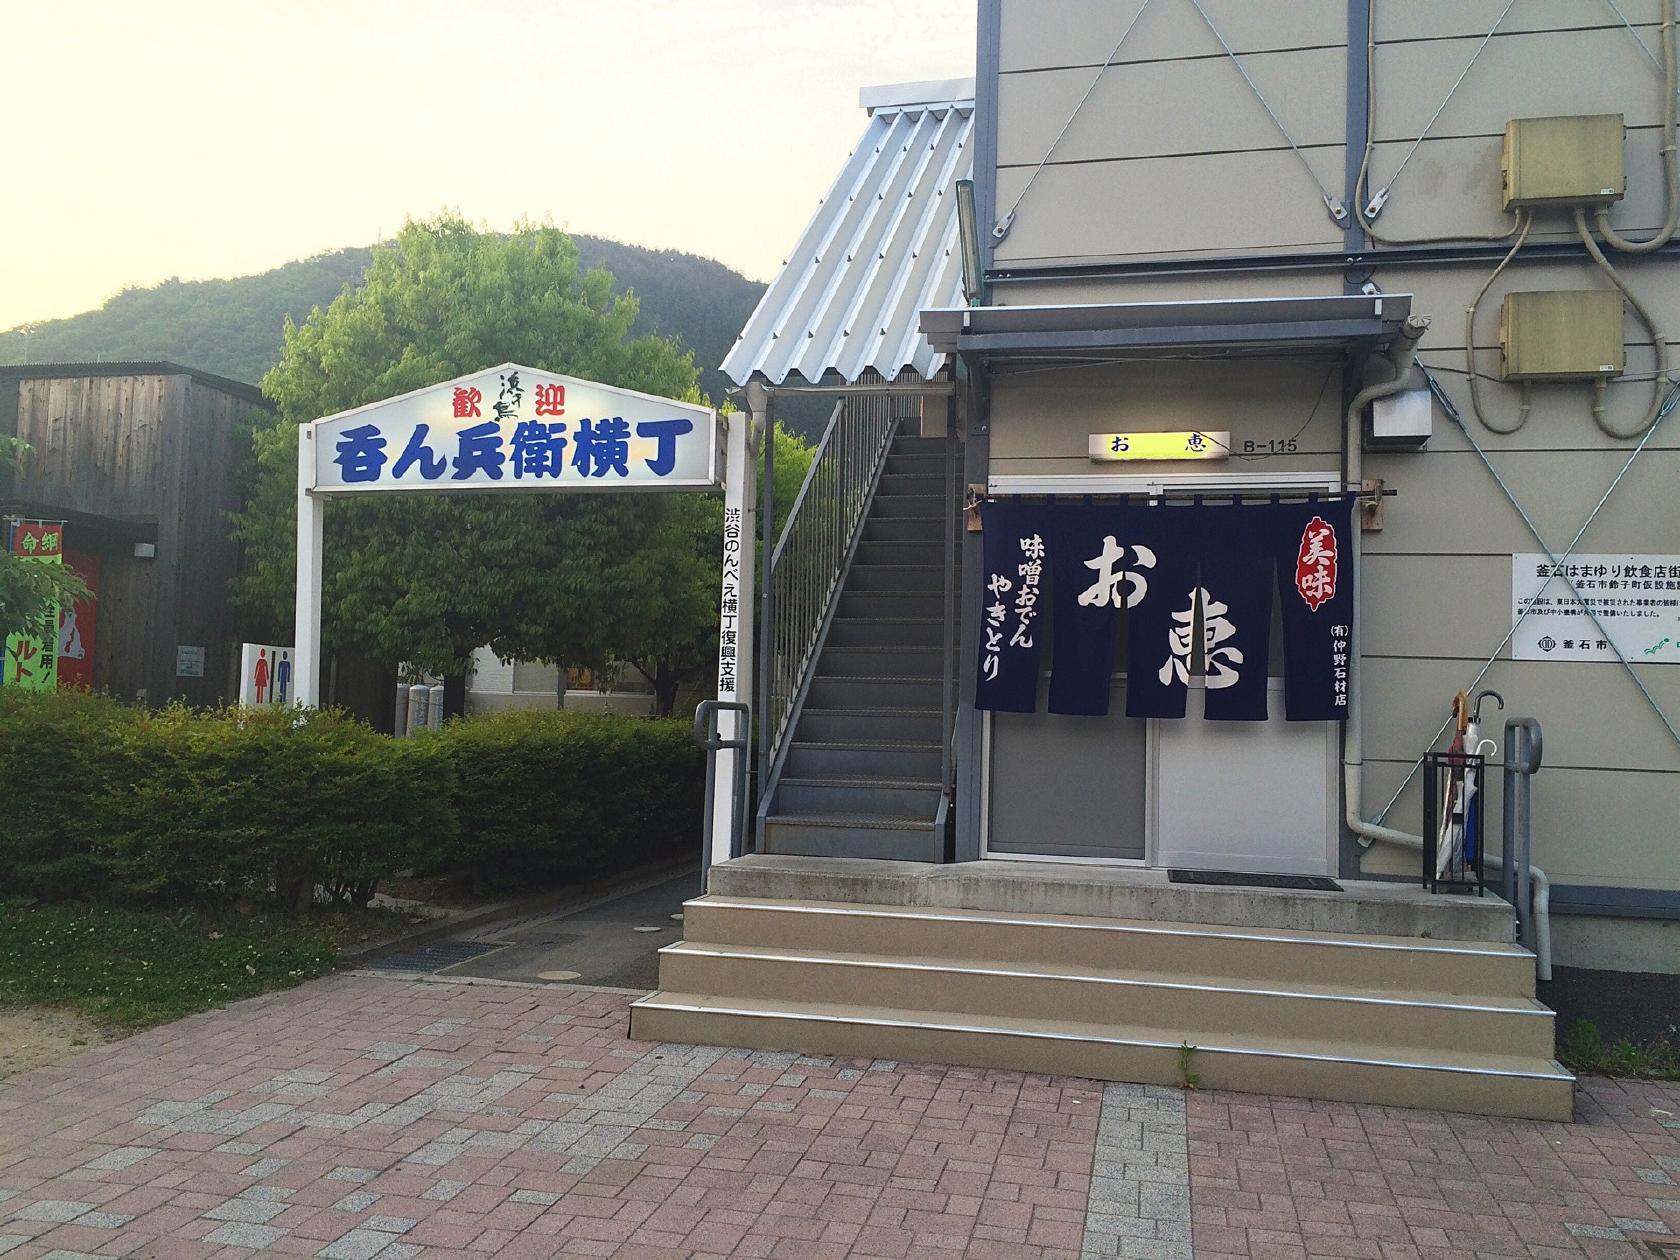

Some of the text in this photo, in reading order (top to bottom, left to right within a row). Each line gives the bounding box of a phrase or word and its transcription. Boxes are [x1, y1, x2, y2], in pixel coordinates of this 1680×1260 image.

[333, 417, 693, 483] 呑ん兵衛横丁
[1243, 439, 1298, 453] B-115
[1009, 533, 1045, 648] 味噌おでん
[1302, 528, 1335, 599] 美味
[719, 507, 741, 693] 渋谷のんべえ横丁復興支援
[983, 573, 1012, 682] やきとり
[1563, 639, 1608, 650] 釜石市
